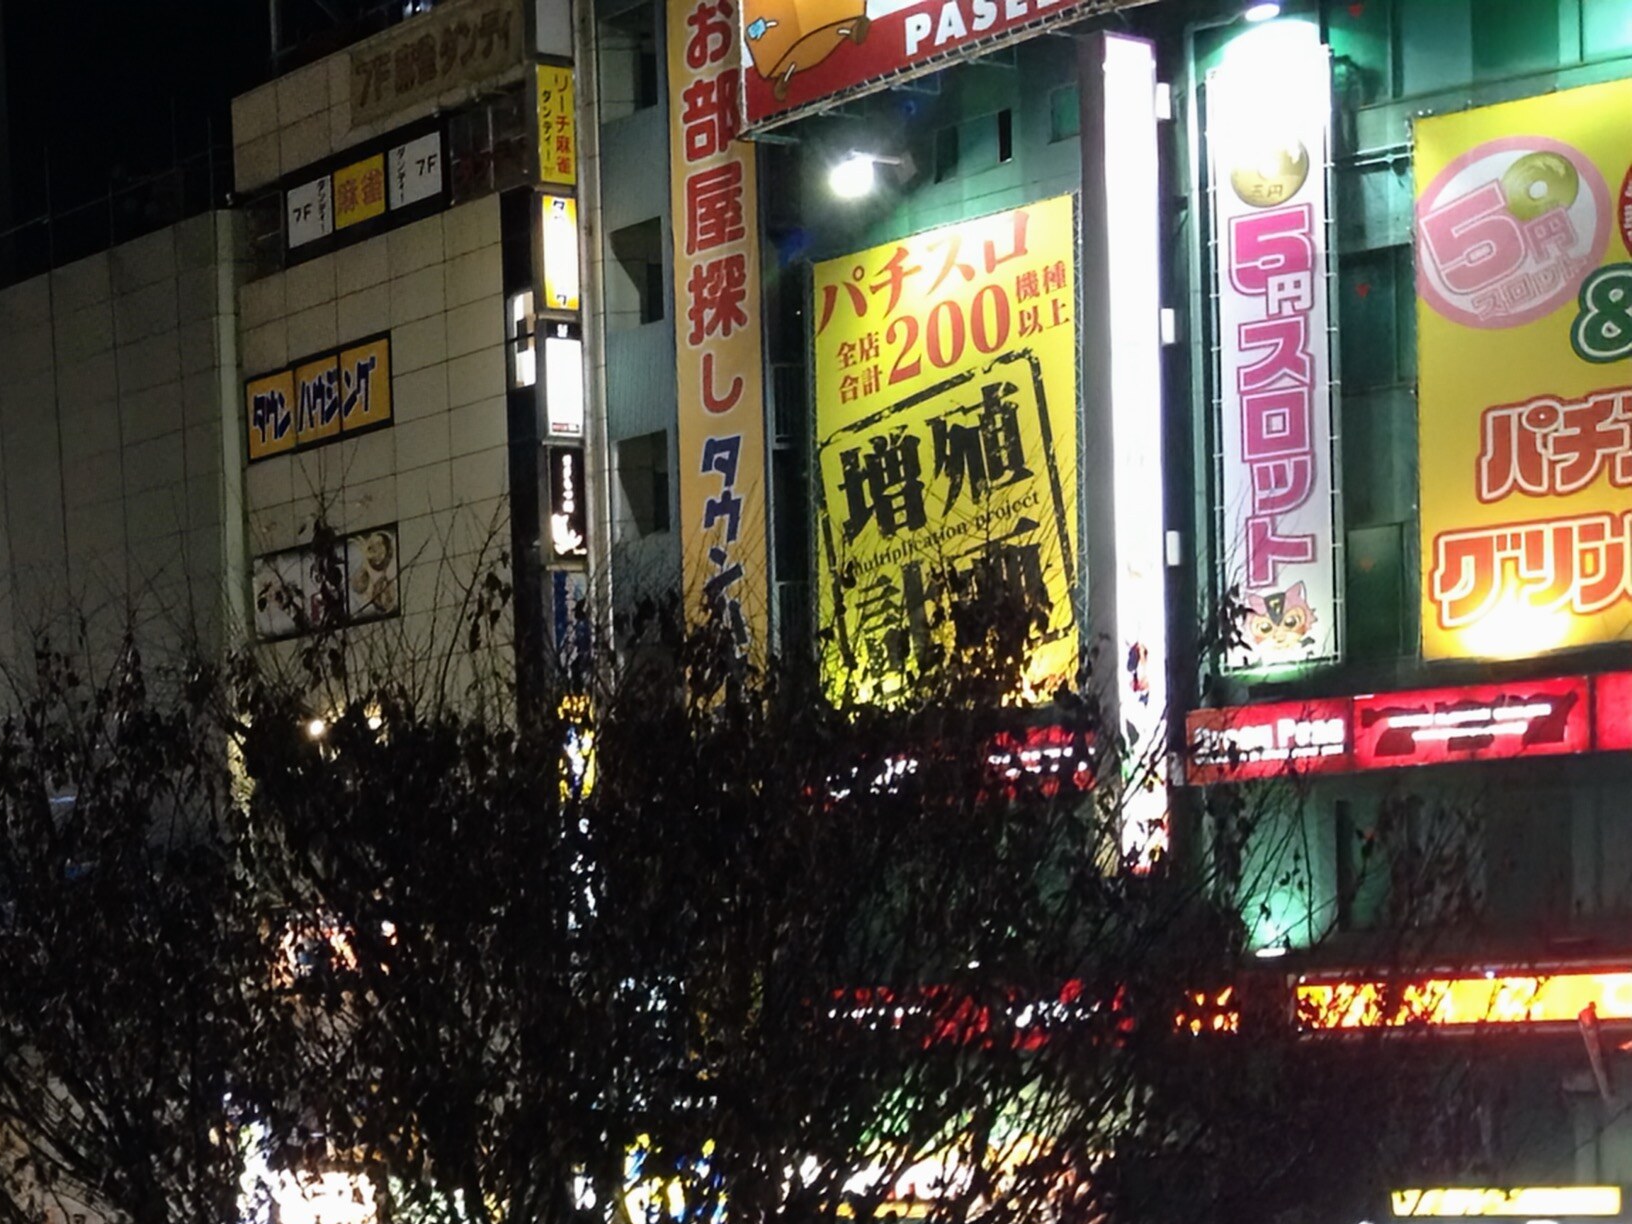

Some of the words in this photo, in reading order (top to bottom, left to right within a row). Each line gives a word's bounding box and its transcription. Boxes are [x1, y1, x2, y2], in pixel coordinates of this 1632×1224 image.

[553, 74, 572, 176] リーチ麻雀
[415, 154, 437, 176] 7F
[293, 203, 312, 223] 7F
[336, 167, 383, 215] 麻雀
[814, 210, 1030, 340] パチスロ
[885, 284, 1011, 386] 200
[1018, 297, 1070, 338] 以上
[836, 330, 881, 372] 全店
[838, 365, 883, 405] 合計
[837, 380, 1035, 546] 増殖
